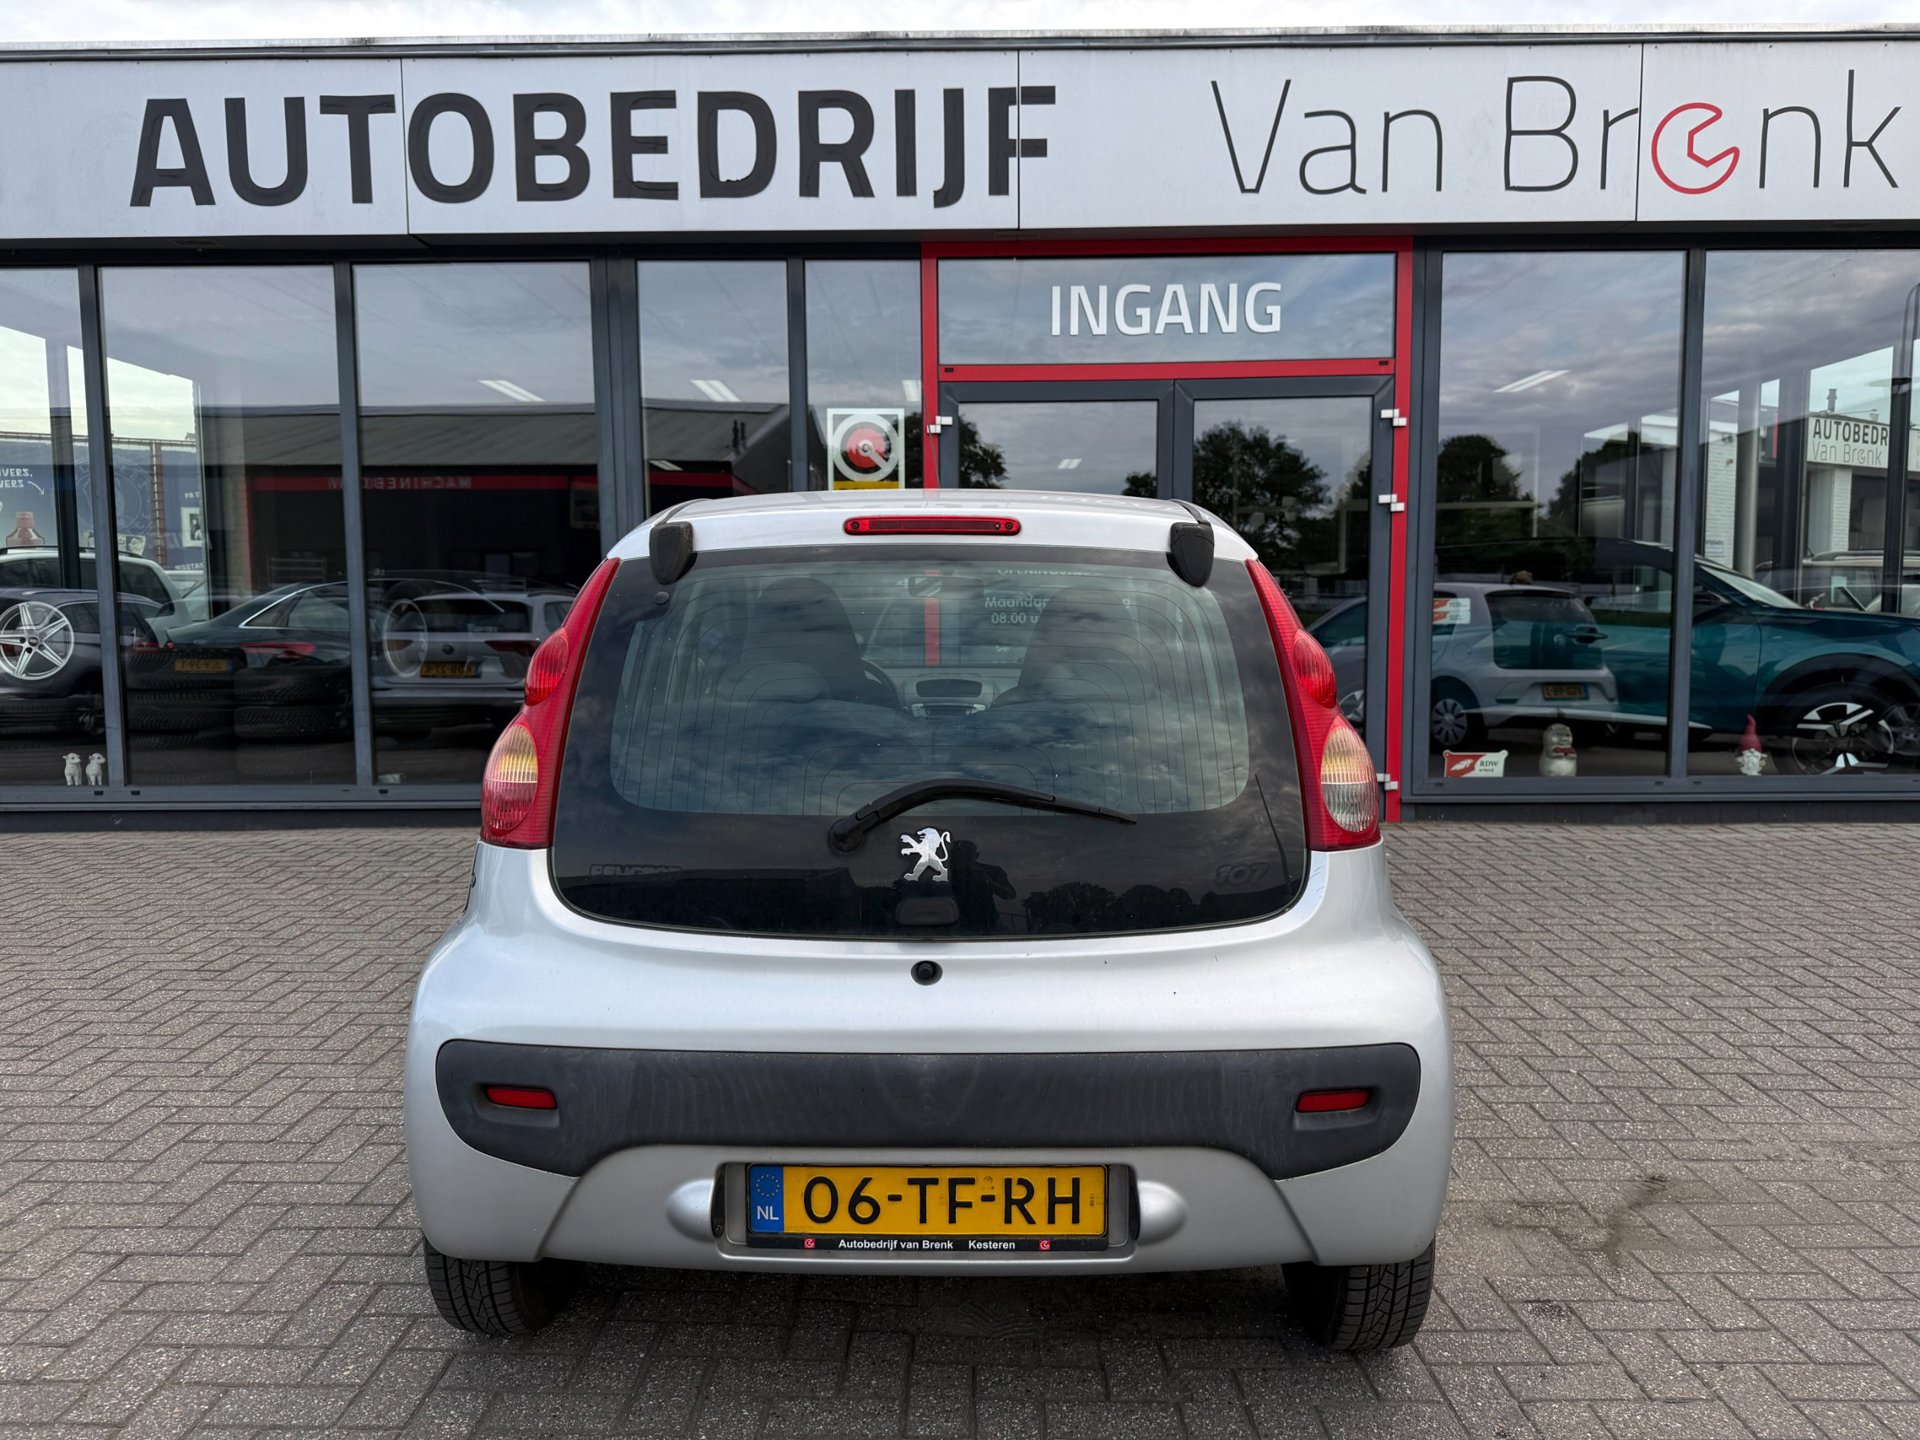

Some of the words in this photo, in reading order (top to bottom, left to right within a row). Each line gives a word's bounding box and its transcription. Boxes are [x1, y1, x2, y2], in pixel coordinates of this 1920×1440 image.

[129, 85, 1056, 208] AUTOBEDRIJF
[1210, 78, 1444, 195] Van
[1050, 281, 1282, 336] INGANG
[1812, 419, 1889, 446] AUTOBEDR
[1812, 439, 1837, 462] Van
[0, 467, 33, 477] VERS,
[991, 612, 1026, 624] 08.00
[1479, 759, 1499, 767] RDW
[1216, 862, 1271, 886] 107
[756, 1205, 779, 1221] NL
[803, 1176, 1080, 1225] 06-TF-RH
[838, 1239, 898, 1251] Autobedrijf
[900, 1241, 919, 1249] van
[922, 1239, 953, 1249] Brenk
[968, 1240, 1016, 1249] Kesteren
